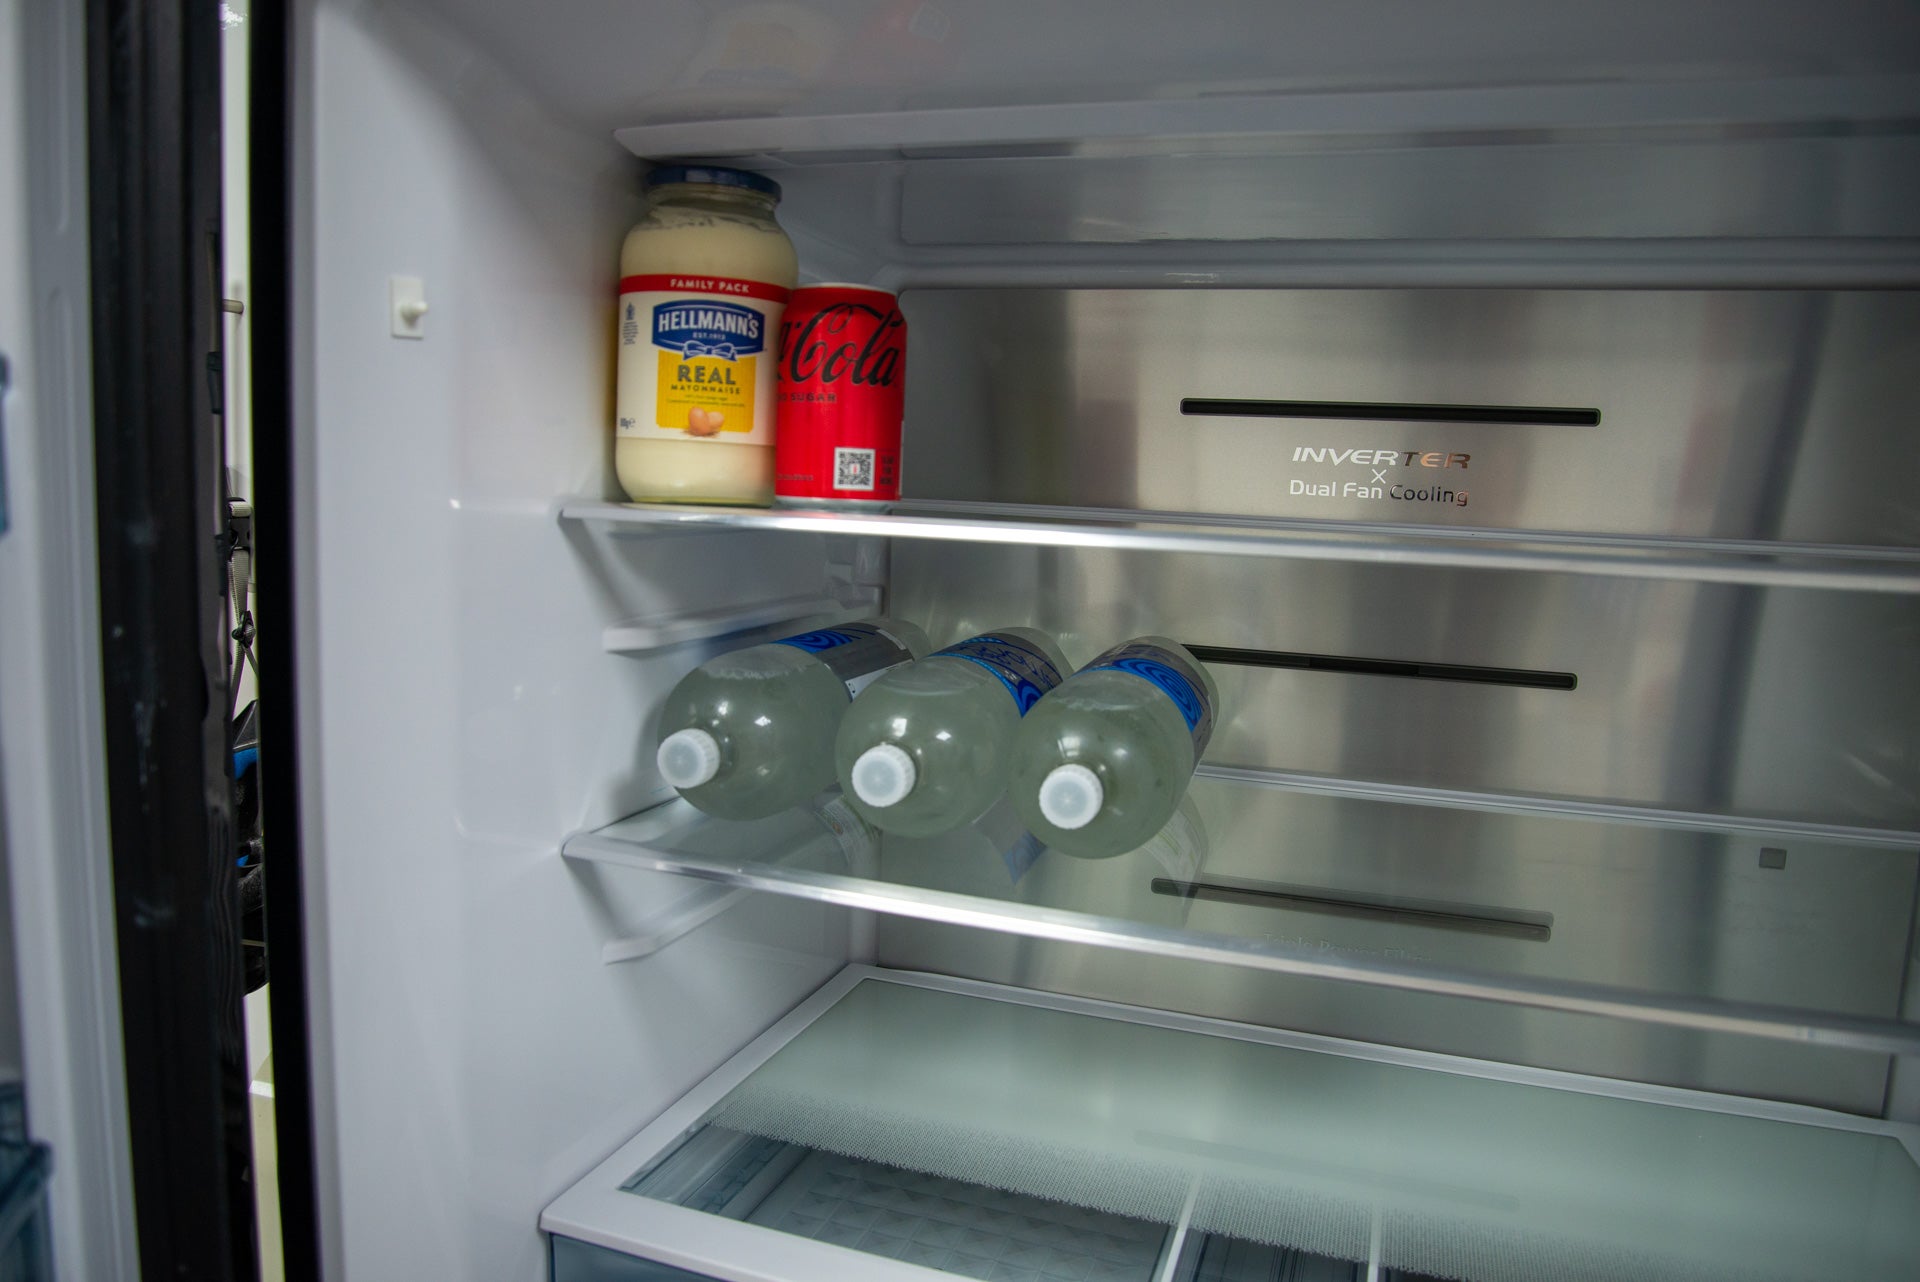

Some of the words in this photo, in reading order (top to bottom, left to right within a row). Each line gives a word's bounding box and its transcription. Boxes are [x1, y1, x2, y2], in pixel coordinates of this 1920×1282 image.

[670, 278, 714, 290] FAMILY
[718, 281, 750, 293] PACK
[658, 310, 760, 339] HELLMANN'S
[677, 364, 737, 385] REAL
[671, 384, 741, 395] MAYONNAISE
[791, 391, 837, 404] SUGAR
[1292, 446, 1471, 469] INVERTER
[1289, 479, 1337, 497] Dual
[1343, 482, 1383, 499] Fan
[1389, 484, 1469, 507] Cooling
